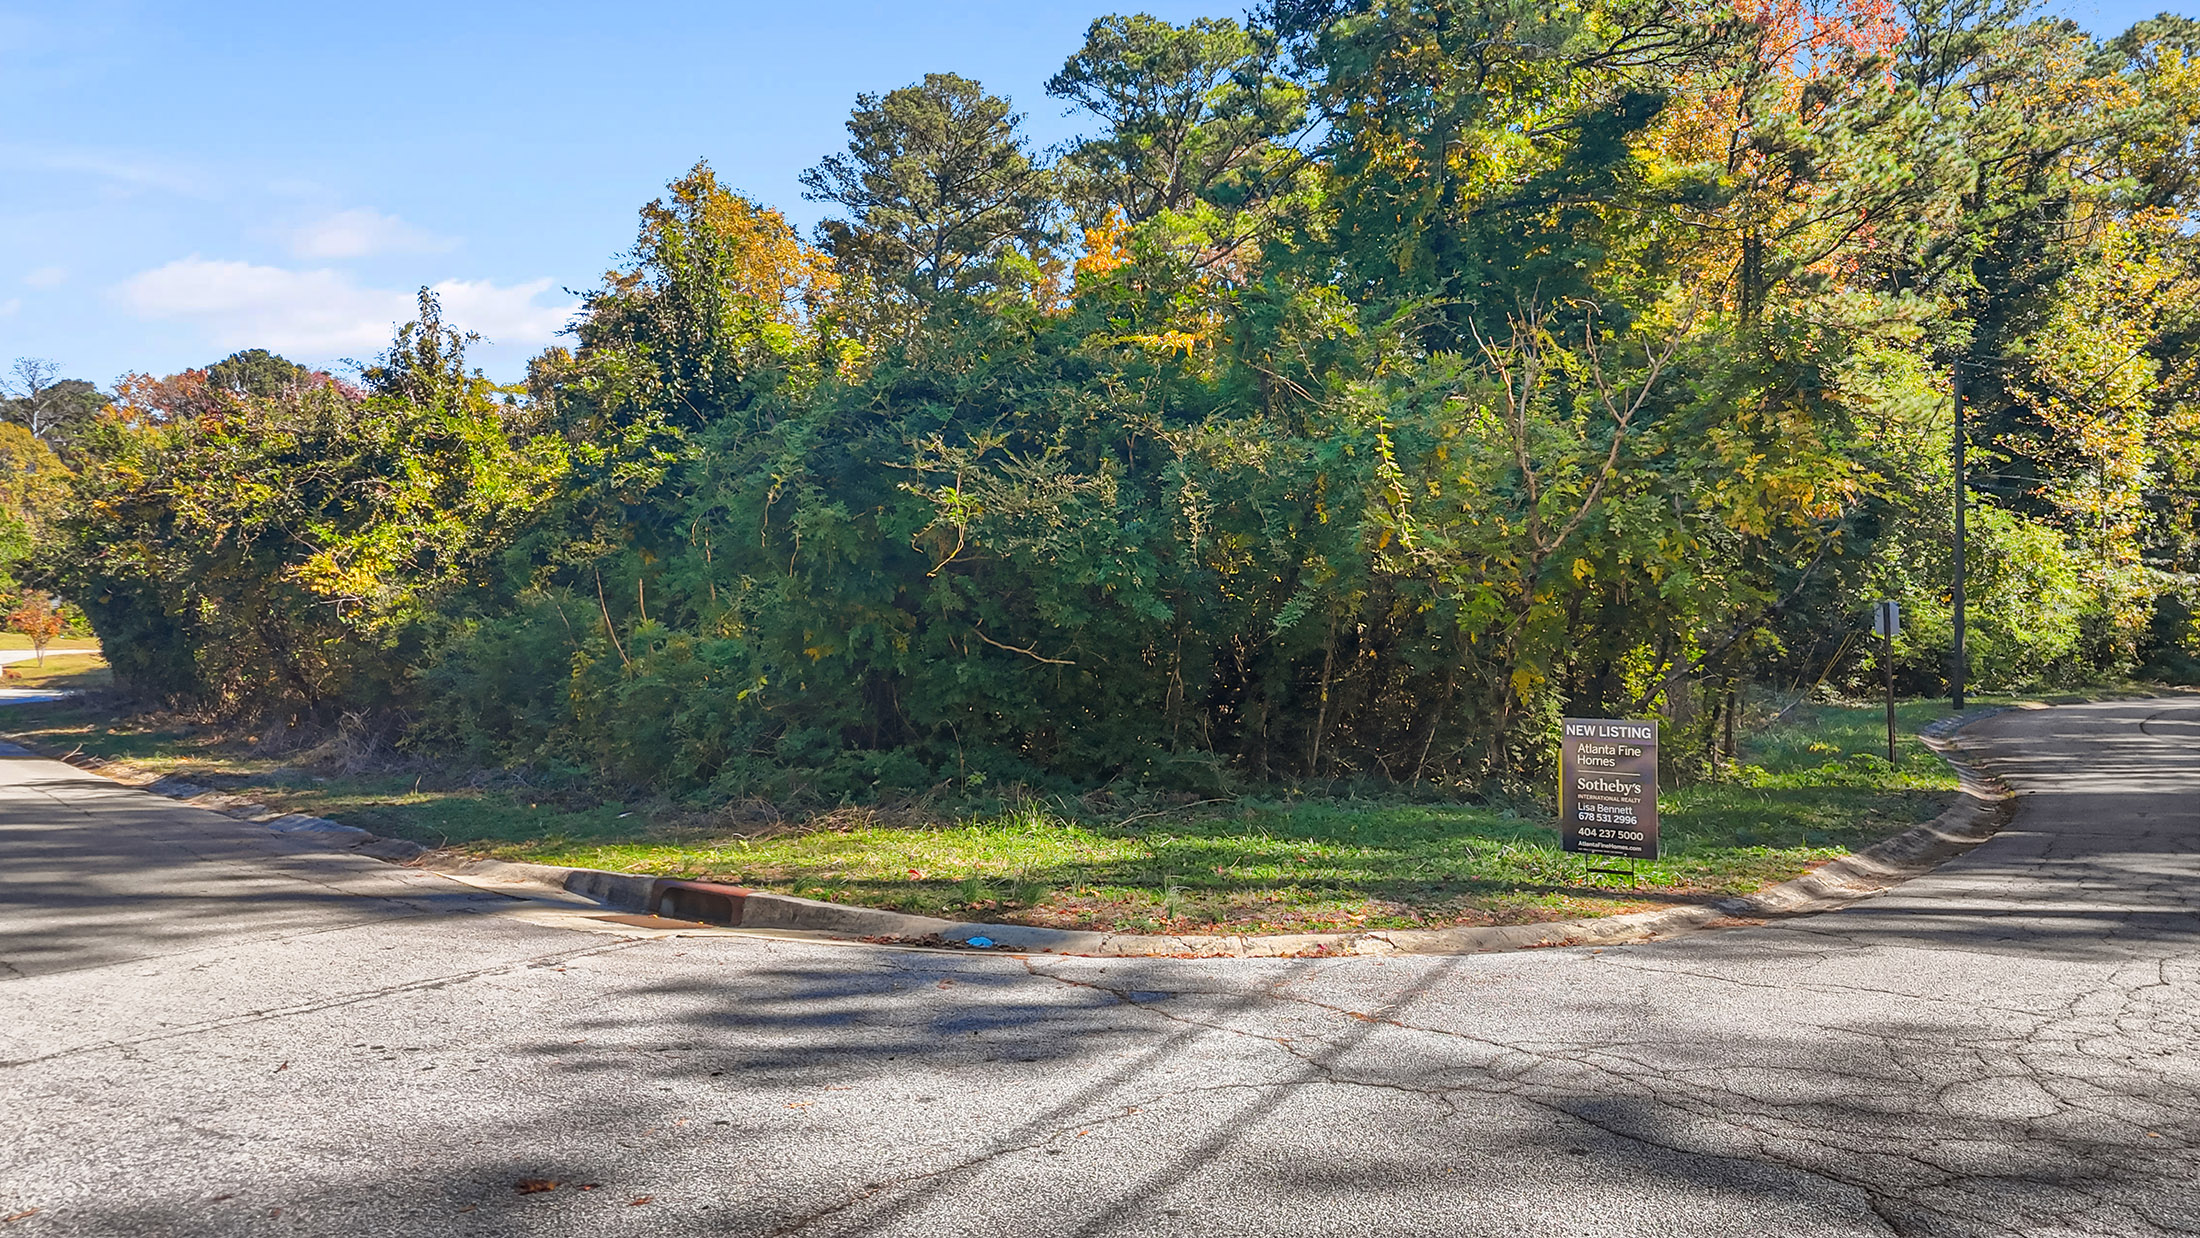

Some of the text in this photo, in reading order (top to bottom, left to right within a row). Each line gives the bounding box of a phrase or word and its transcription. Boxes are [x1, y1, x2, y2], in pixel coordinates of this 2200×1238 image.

[1566, 724, 1652, 739] NEW LISTING
[1577, 743, 1641, 757] Atlanta Fine
[1577, 755, 1616, 767] Homes
[1577, 777, 1642, 796] Sotheby's
[1577, 794, 1620, 802] INTERNATIONAL
[1577, 802, 1633, 815] Lisa Bennett
[1578, 812, 1638, 825] 678 531 2996
[1578, 827, 1644, 841] 404 237 5000
[1578, 840, 1642, 852] AtlantaFineHomes.com
